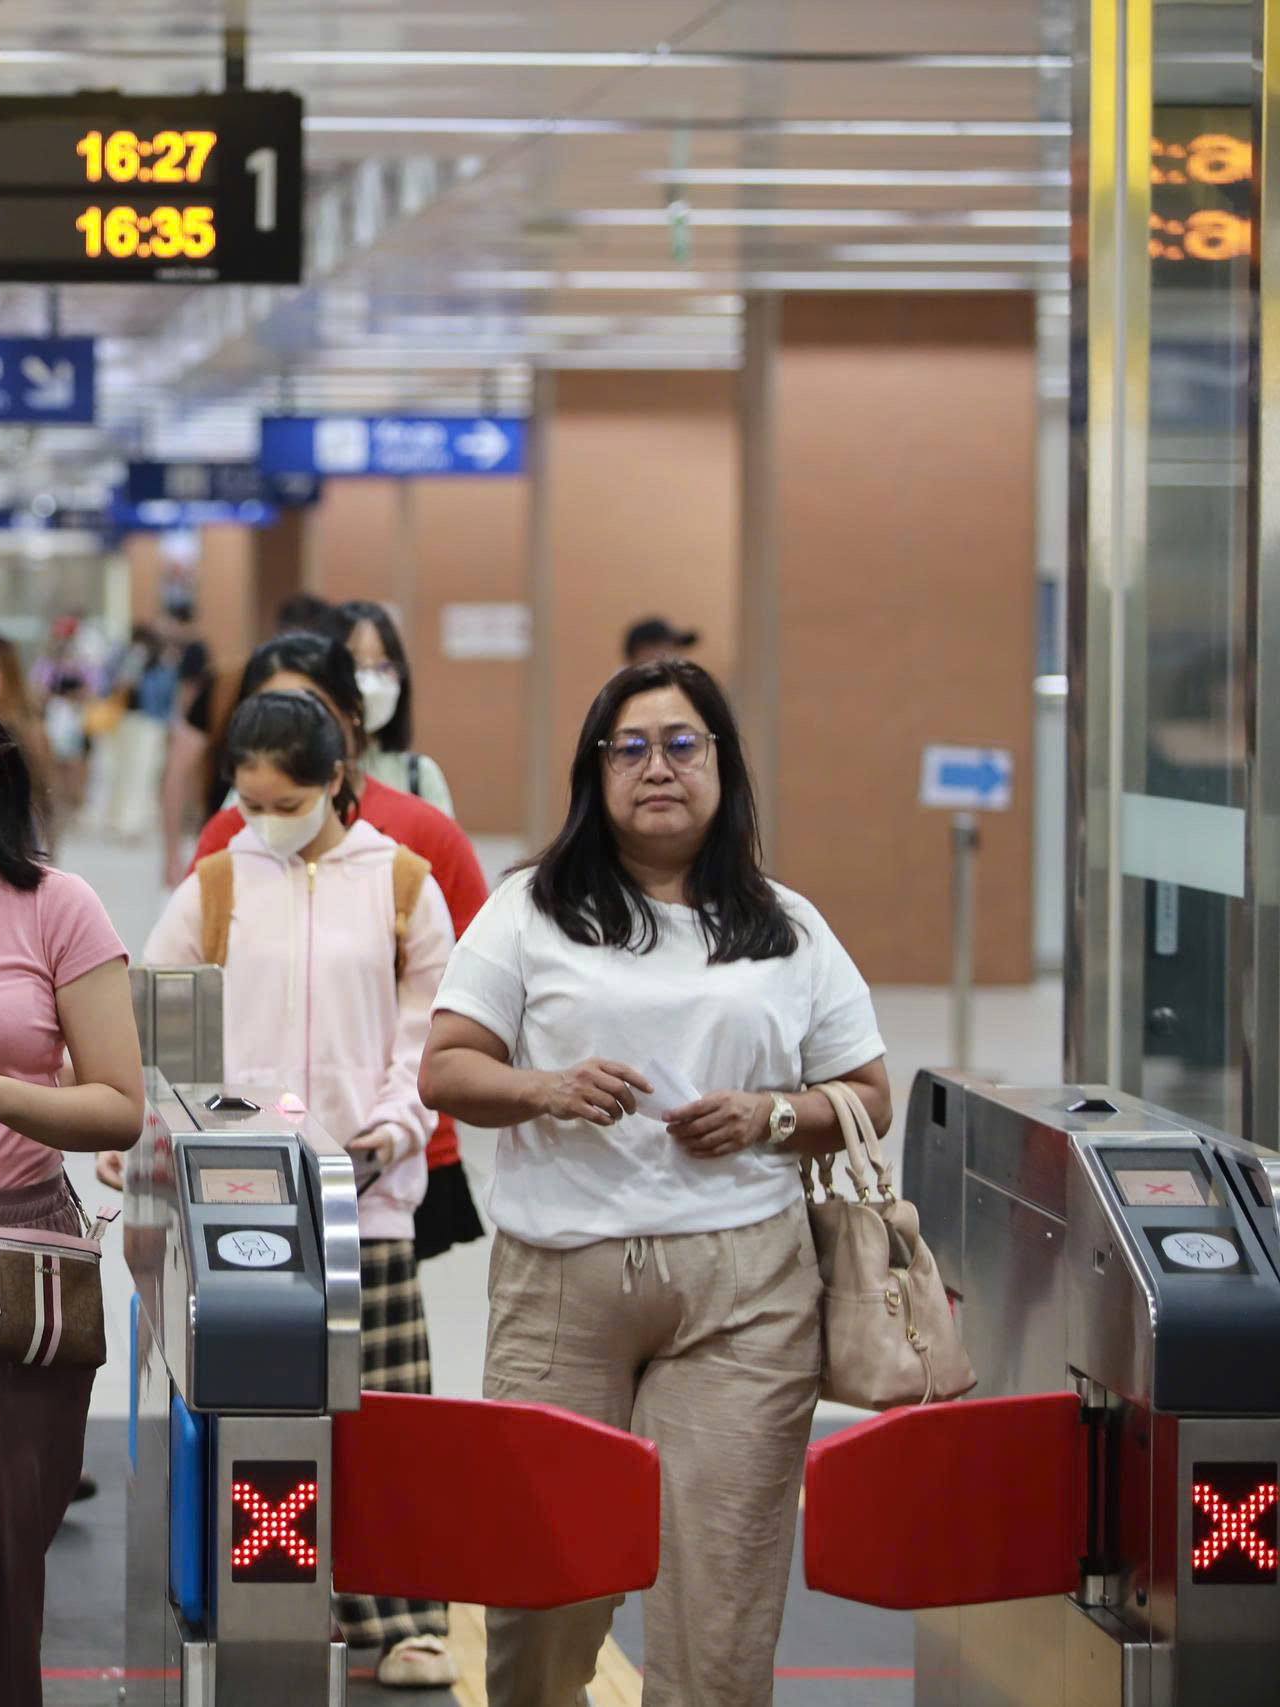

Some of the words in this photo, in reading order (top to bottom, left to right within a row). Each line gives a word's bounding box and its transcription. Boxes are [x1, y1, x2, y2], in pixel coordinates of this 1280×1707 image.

[76, 130, 216, 182] 16:27
[245, 147, 278, 232] 1
[76, 206, 216, 258] 16:35
